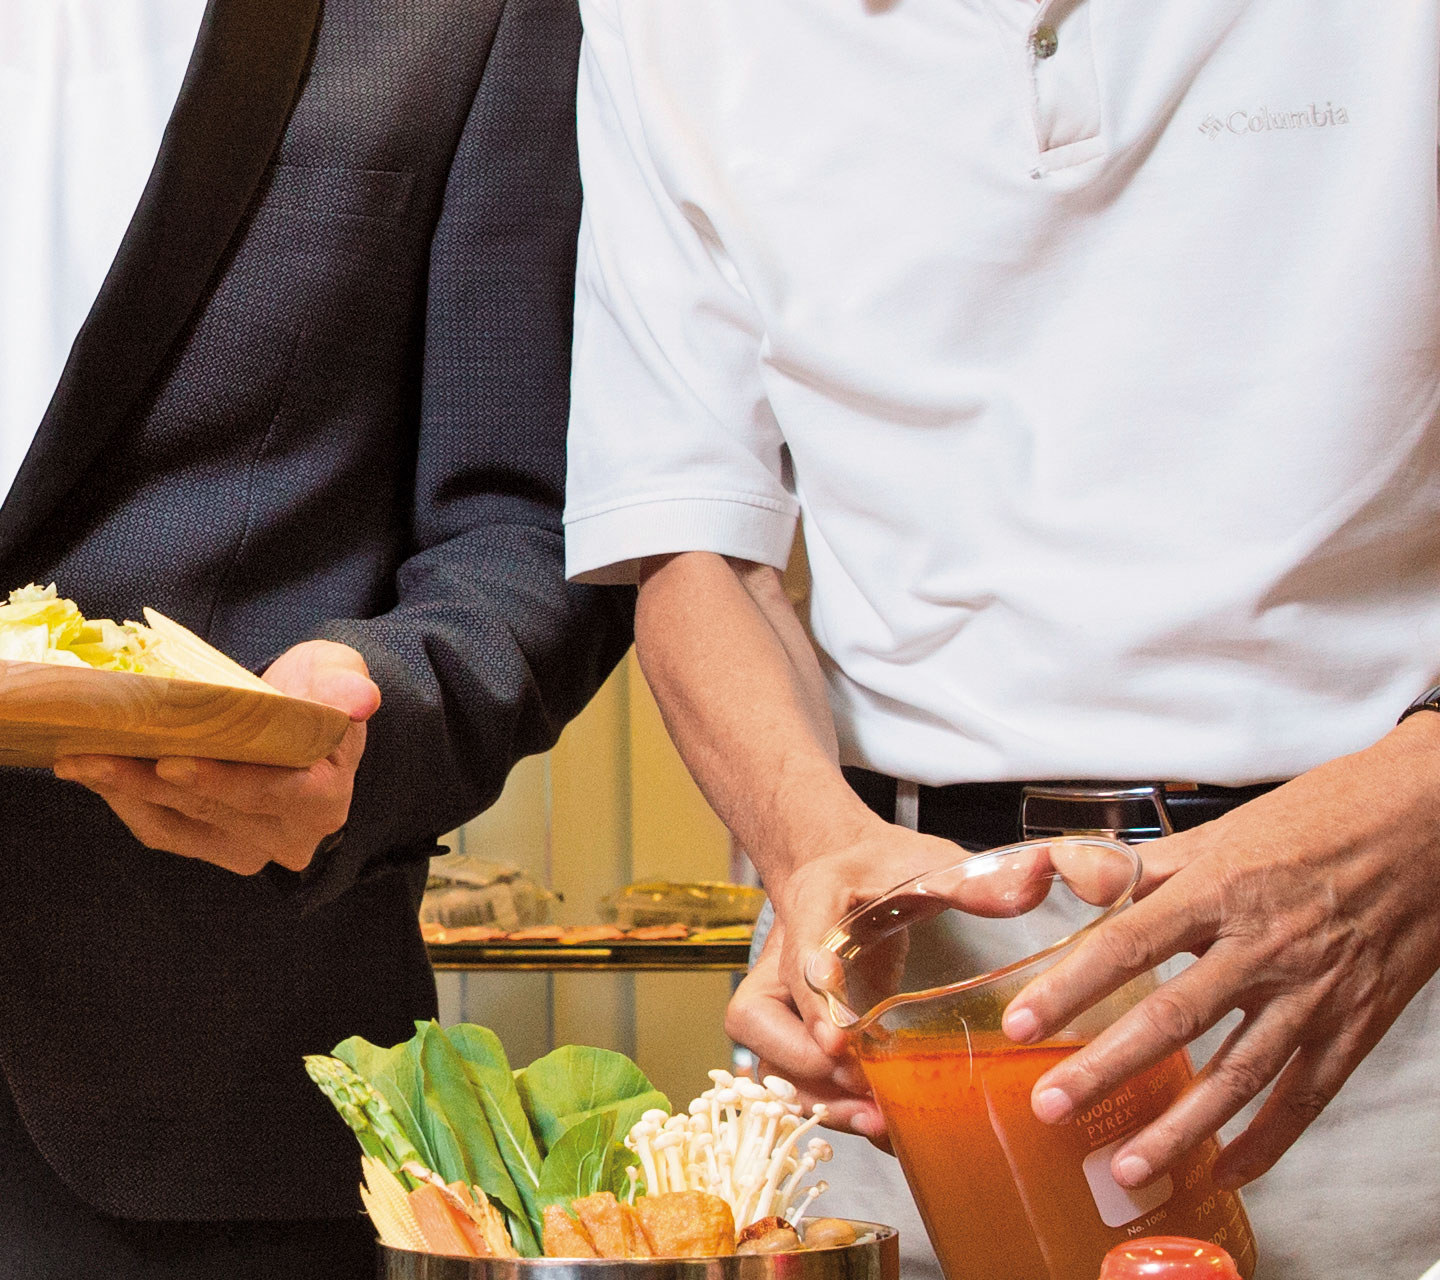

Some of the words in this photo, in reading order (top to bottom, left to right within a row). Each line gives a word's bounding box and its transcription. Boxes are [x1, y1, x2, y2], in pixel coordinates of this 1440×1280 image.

[1225, 101, 1349, 136] Columbia
[1087, 1107, 1133, 1139] PYREX
[1185, 1165, 1205, 1190] 600
[1195, 1196, 1216, 1221] 700
[1126, 1222, 1145, 1237] No.
